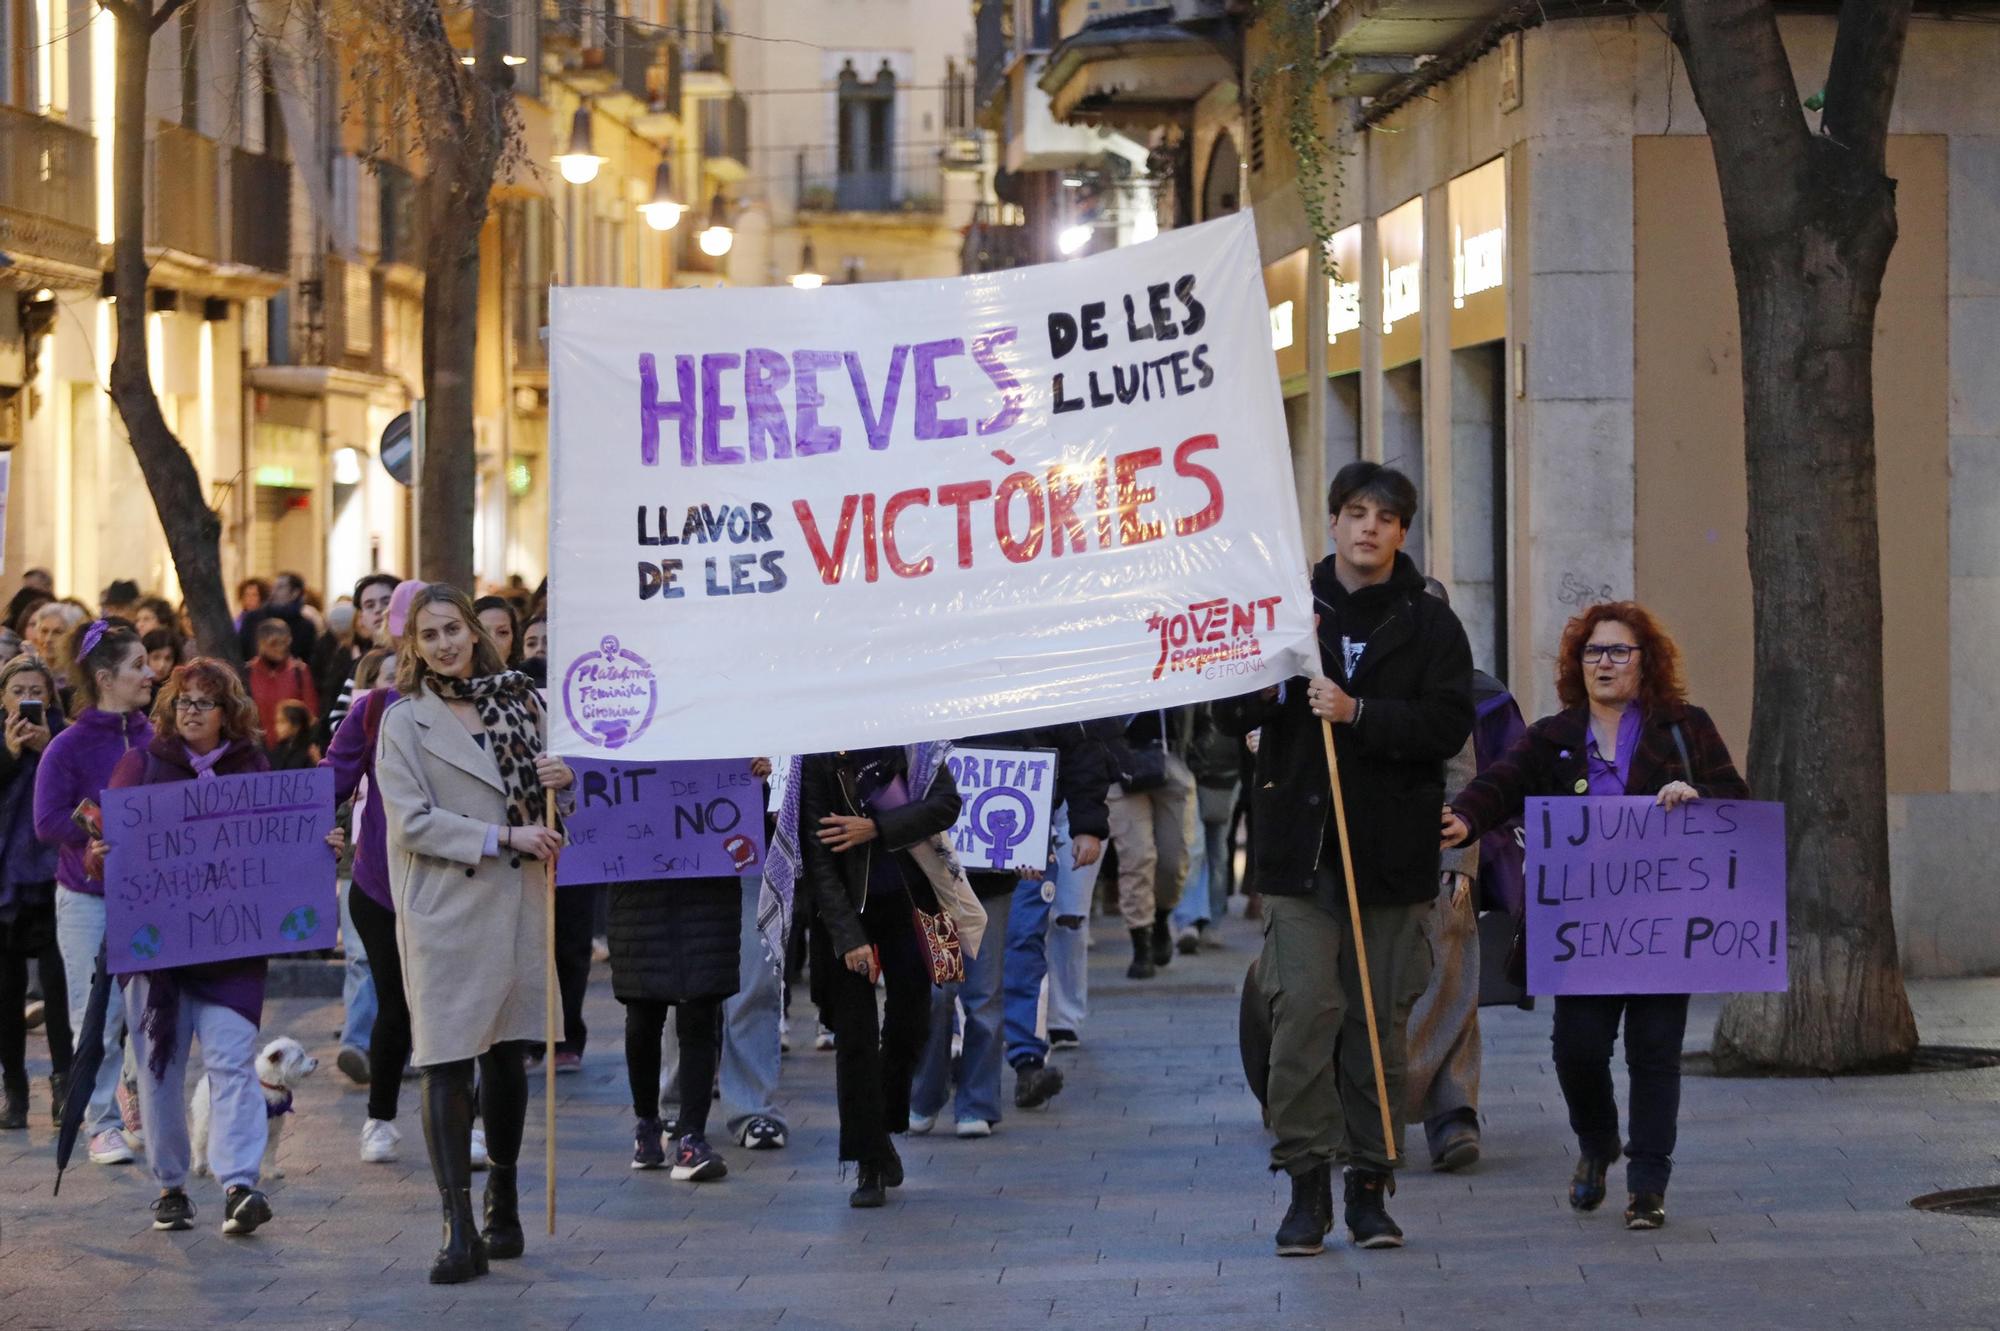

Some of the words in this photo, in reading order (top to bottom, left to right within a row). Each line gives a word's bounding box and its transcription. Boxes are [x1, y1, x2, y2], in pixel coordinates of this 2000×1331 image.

[1048, 301, 1108, 359] DE
[1123, 274, 1206, 341] LES
[638, 326, 1025, 467] HEREVES
[1052, 343, 1215, 414] LLUITES
[637, 503, 775, 546] LLAVOR
[792, 433, 1223, 585] VICTÒRIES
[638, 557, 684, 600] DE
[705, 550, 788, 598] LES
[1152, 595, 1282, 680] JOVENT
[579, 683, 647, 703] Feminista
[1205, 658, 1266, 680] GIRONA
[123, 795, 152, 828] SI
[184, 772, 316, 818] NOSALTRES
[670, 780, 700, 796] DE
[716, 772, 753, 790] LES
[148, 826, 197, 861] ENS
[213, 814, 318, 851] ATUREM
[568, 828, 598, 846] UE
[627, 823, 655, 840] JA
[675, 797, 742, 840] NO
[243, 858, 281, 888] EL
[1537, 857, 1710, 905] LLIURES
[188, 898, 263, 949] MÓN
[1553, 917, 1673, 962] SENSE
